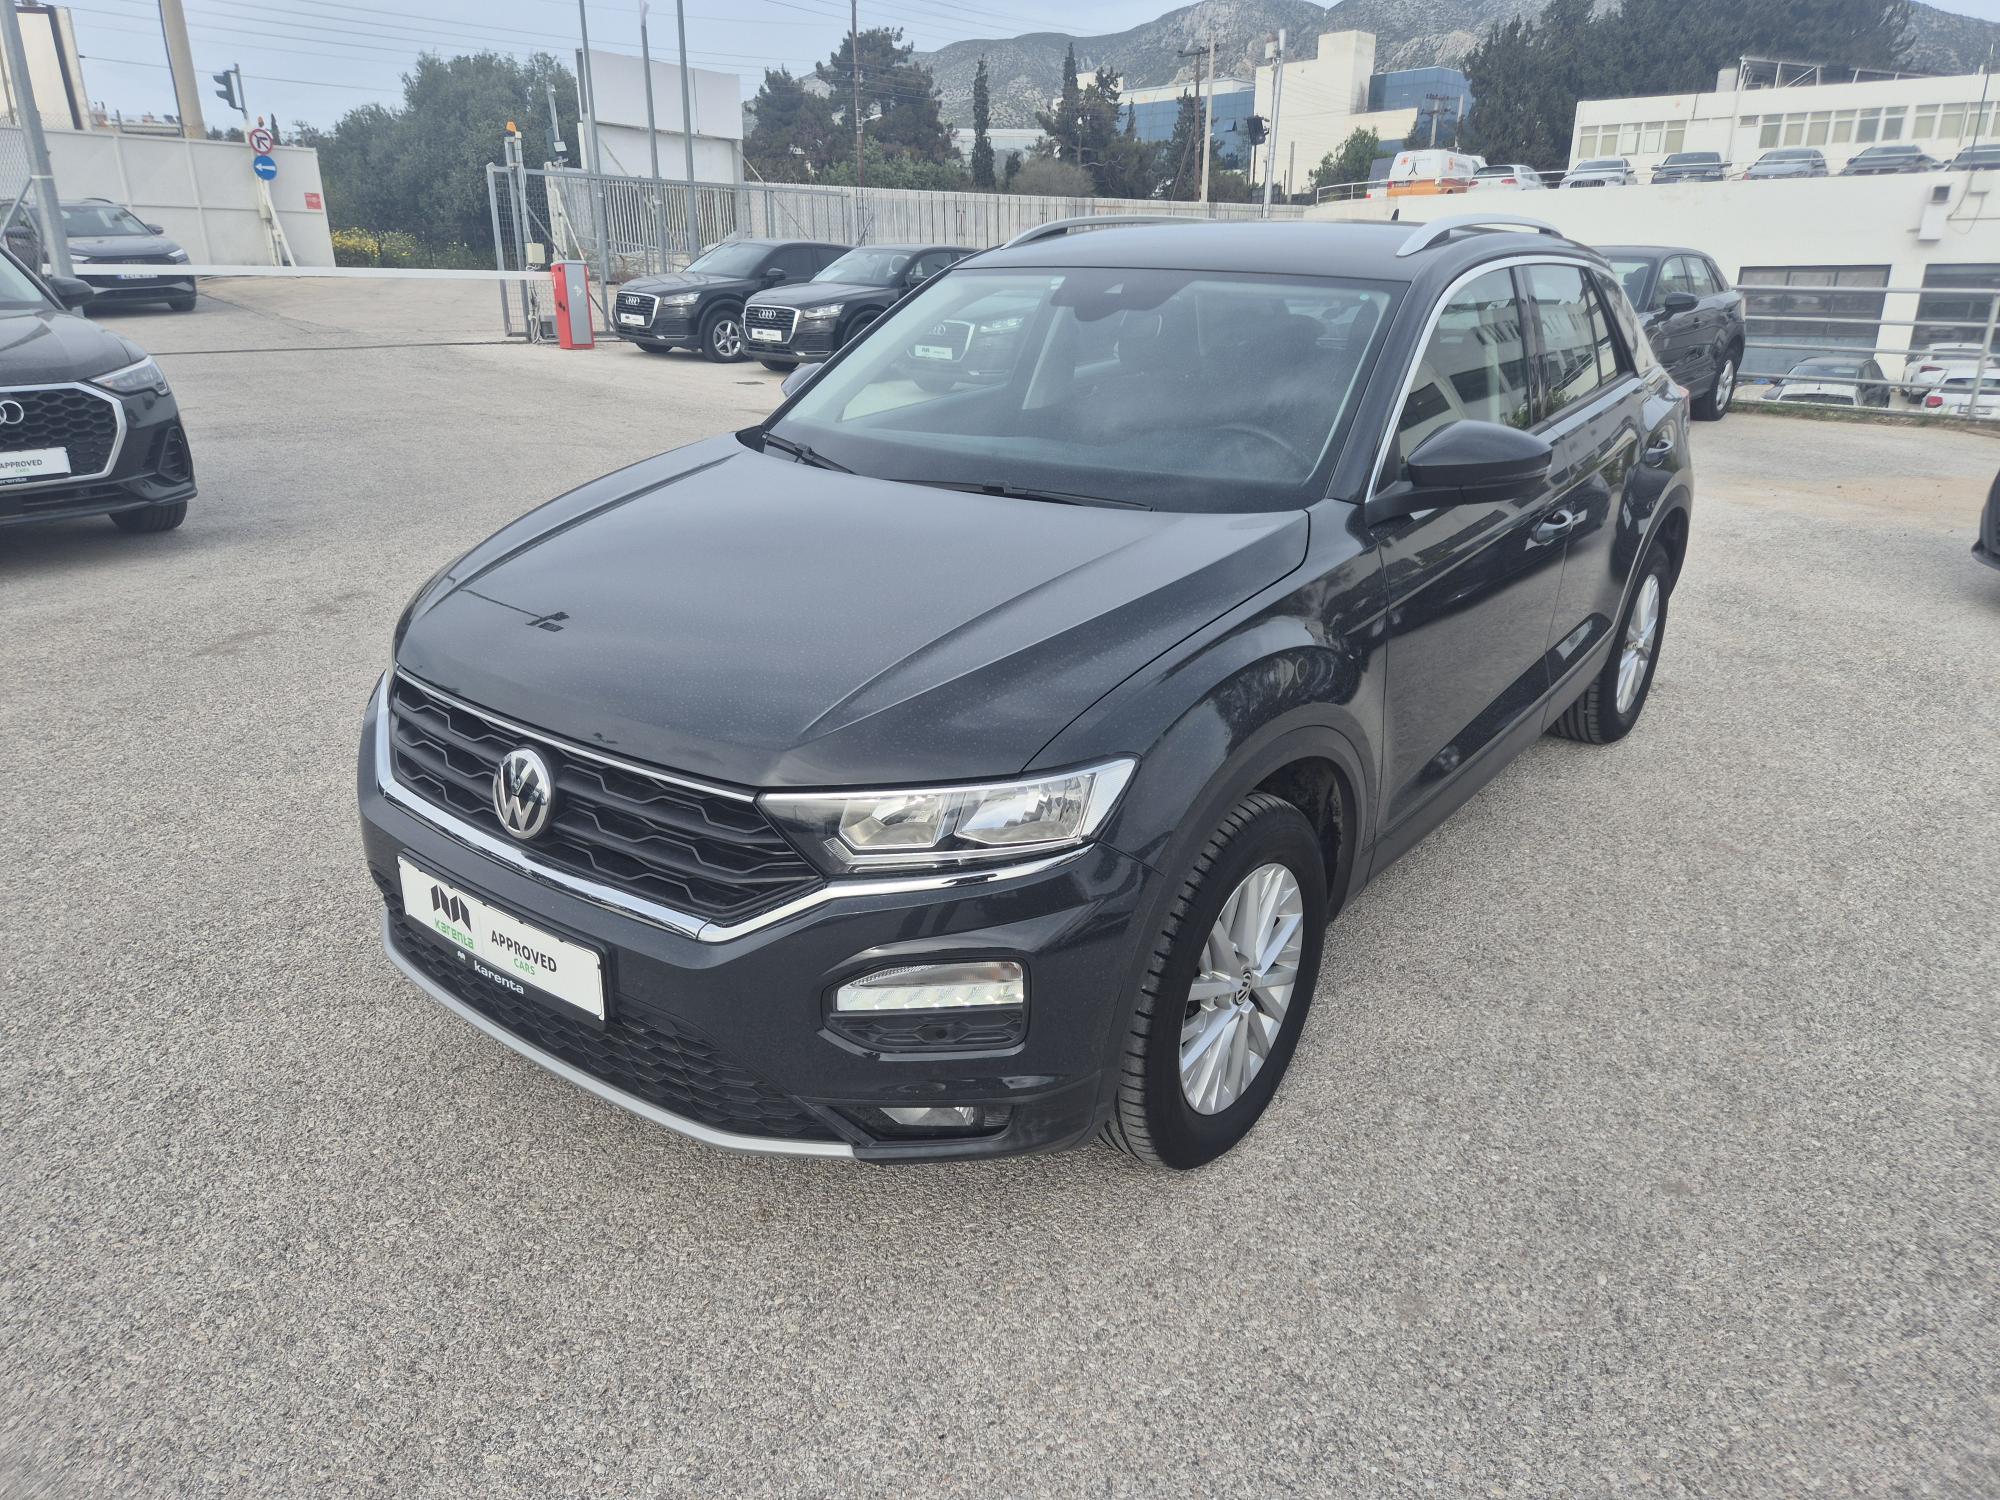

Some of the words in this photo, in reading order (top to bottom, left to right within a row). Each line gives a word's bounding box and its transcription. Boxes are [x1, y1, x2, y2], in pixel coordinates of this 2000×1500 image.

[434, 918, 475, 950] karenta
[491, 929, 558, 973] APPROVED
[474, 959, 525, 995] karenta
[513, 958, 536, 976] CARS
